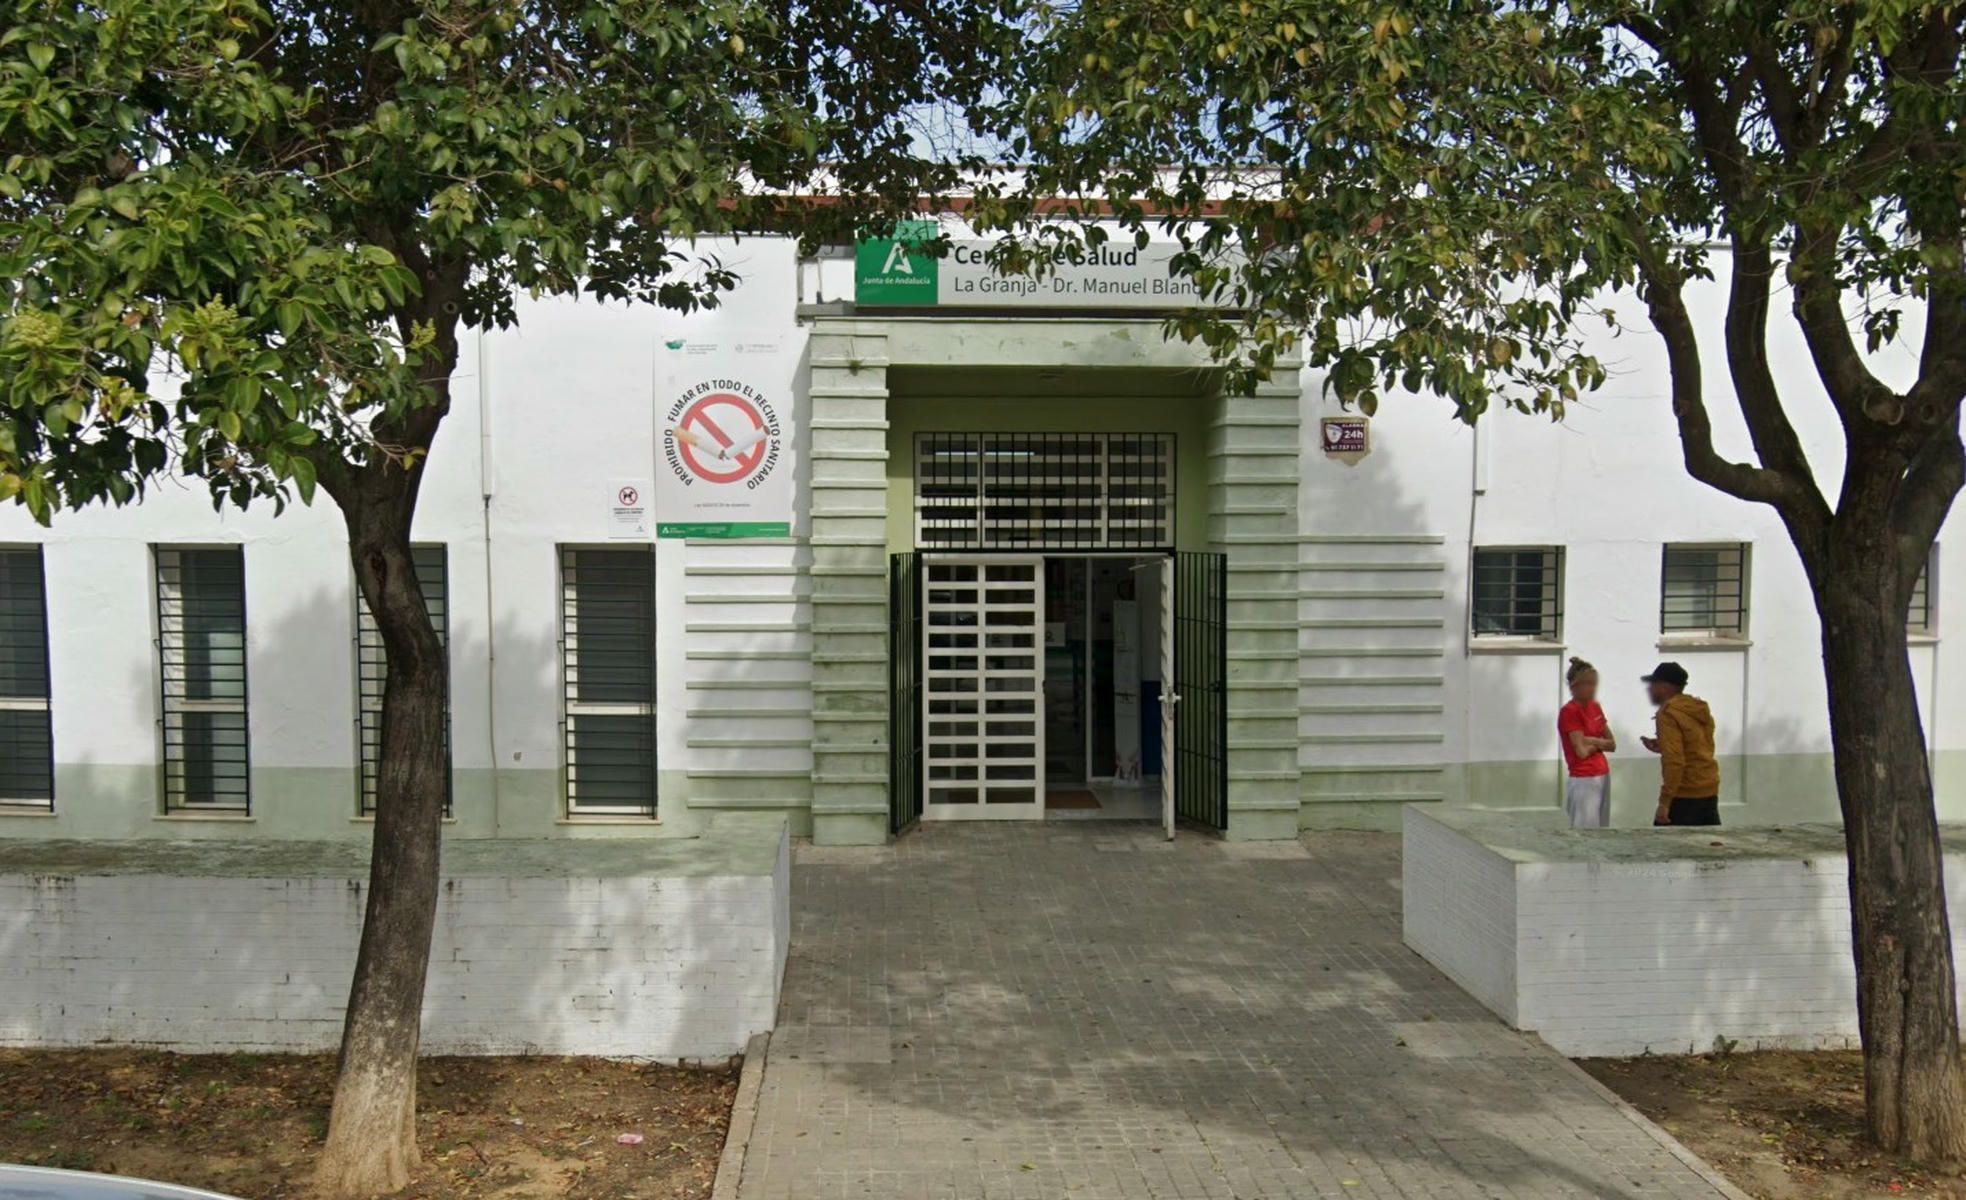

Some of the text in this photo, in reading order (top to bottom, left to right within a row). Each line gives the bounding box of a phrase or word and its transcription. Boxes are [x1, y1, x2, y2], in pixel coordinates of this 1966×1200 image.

[955, 277, 974, 292] La
[980, 277, 1037, 297] Granja
[1054, 278, 1078, 293] Dr.
[1084, 277, 1147, 294] Manuel
[664, 379, 781, 490] PROHIBIDO FUMAR EN TODO EL RECINTO SANITARIO
[1344, 430, 1363, 439] 24h
